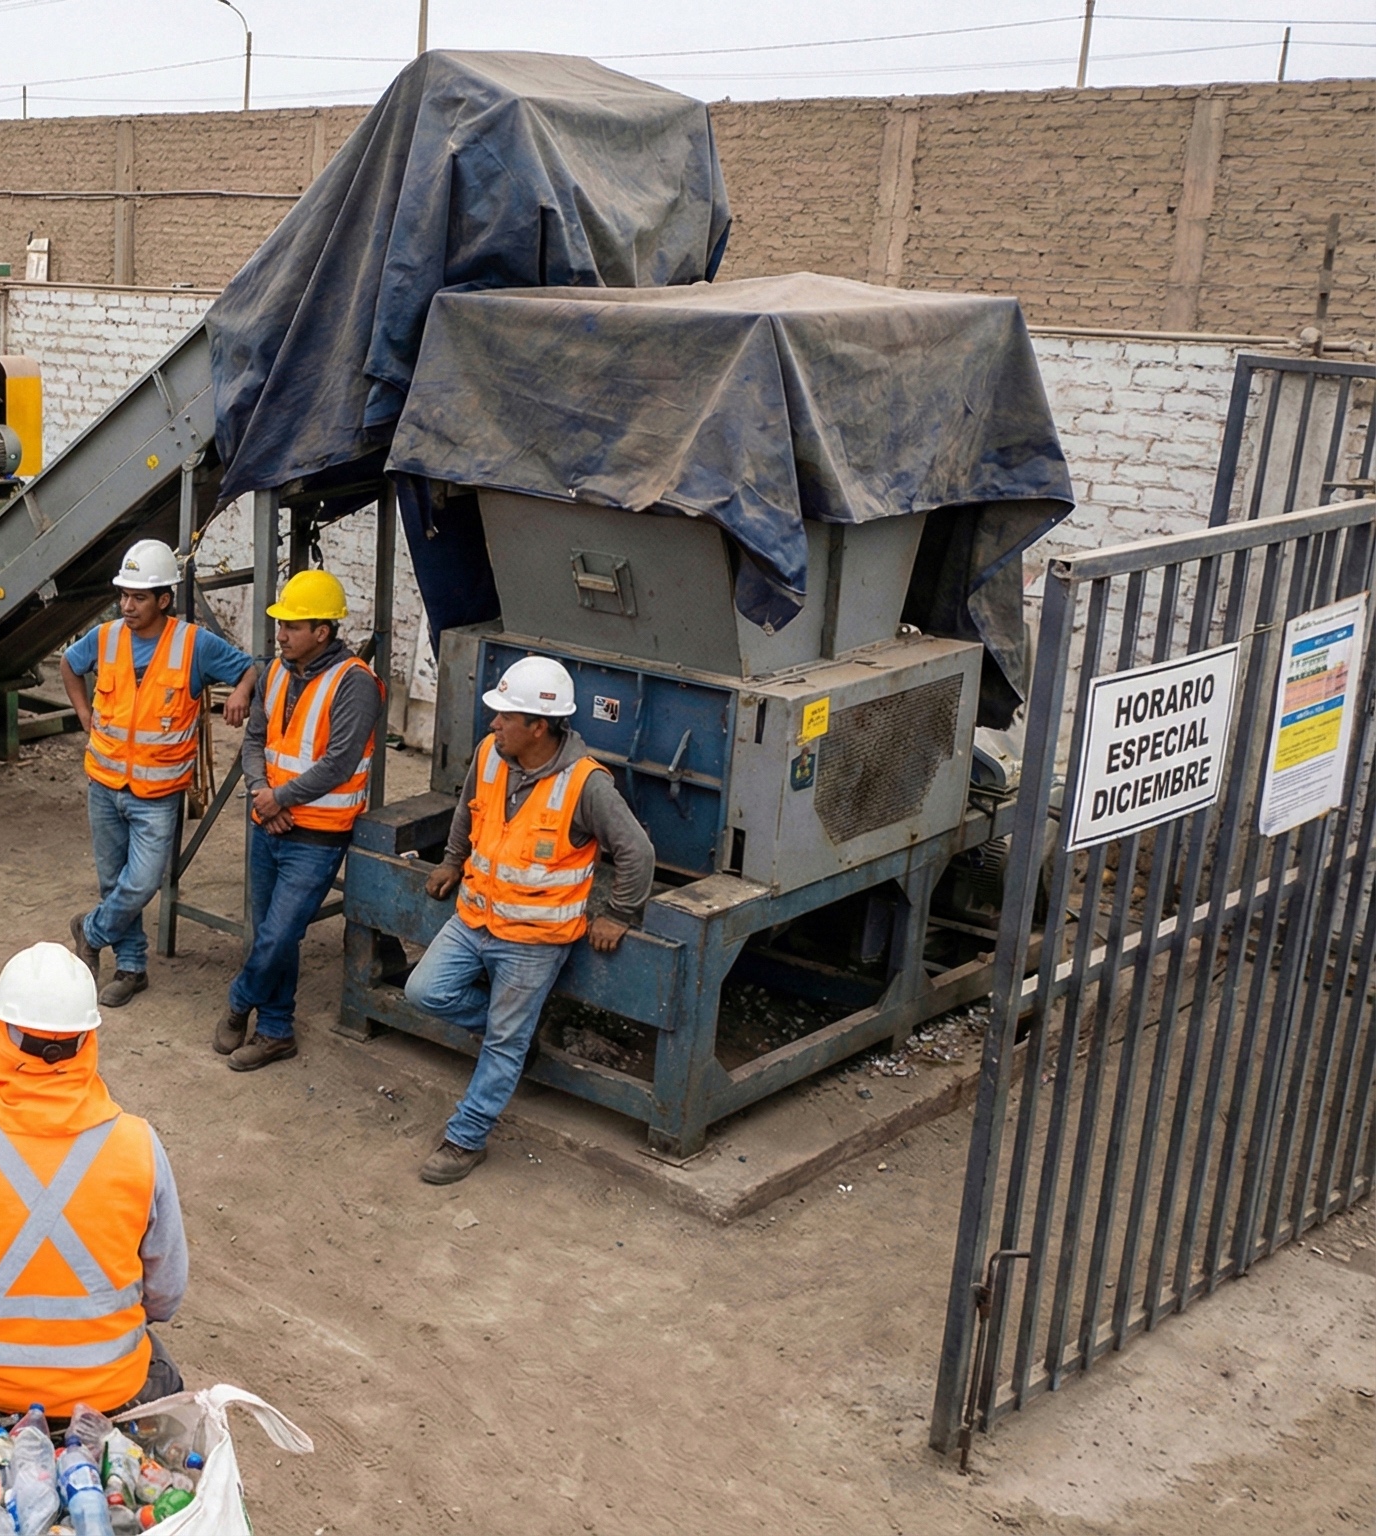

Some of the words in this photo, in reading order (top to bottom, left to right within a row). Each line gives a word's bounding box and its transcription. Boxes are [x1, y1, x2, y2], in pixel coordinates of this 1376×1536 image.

[1114, 673, 1215, 729] HORARIO
[1106, 717, 1209, 775] ESPECIAL
[1091, 755, 1212, 822] DICIEMBRE
